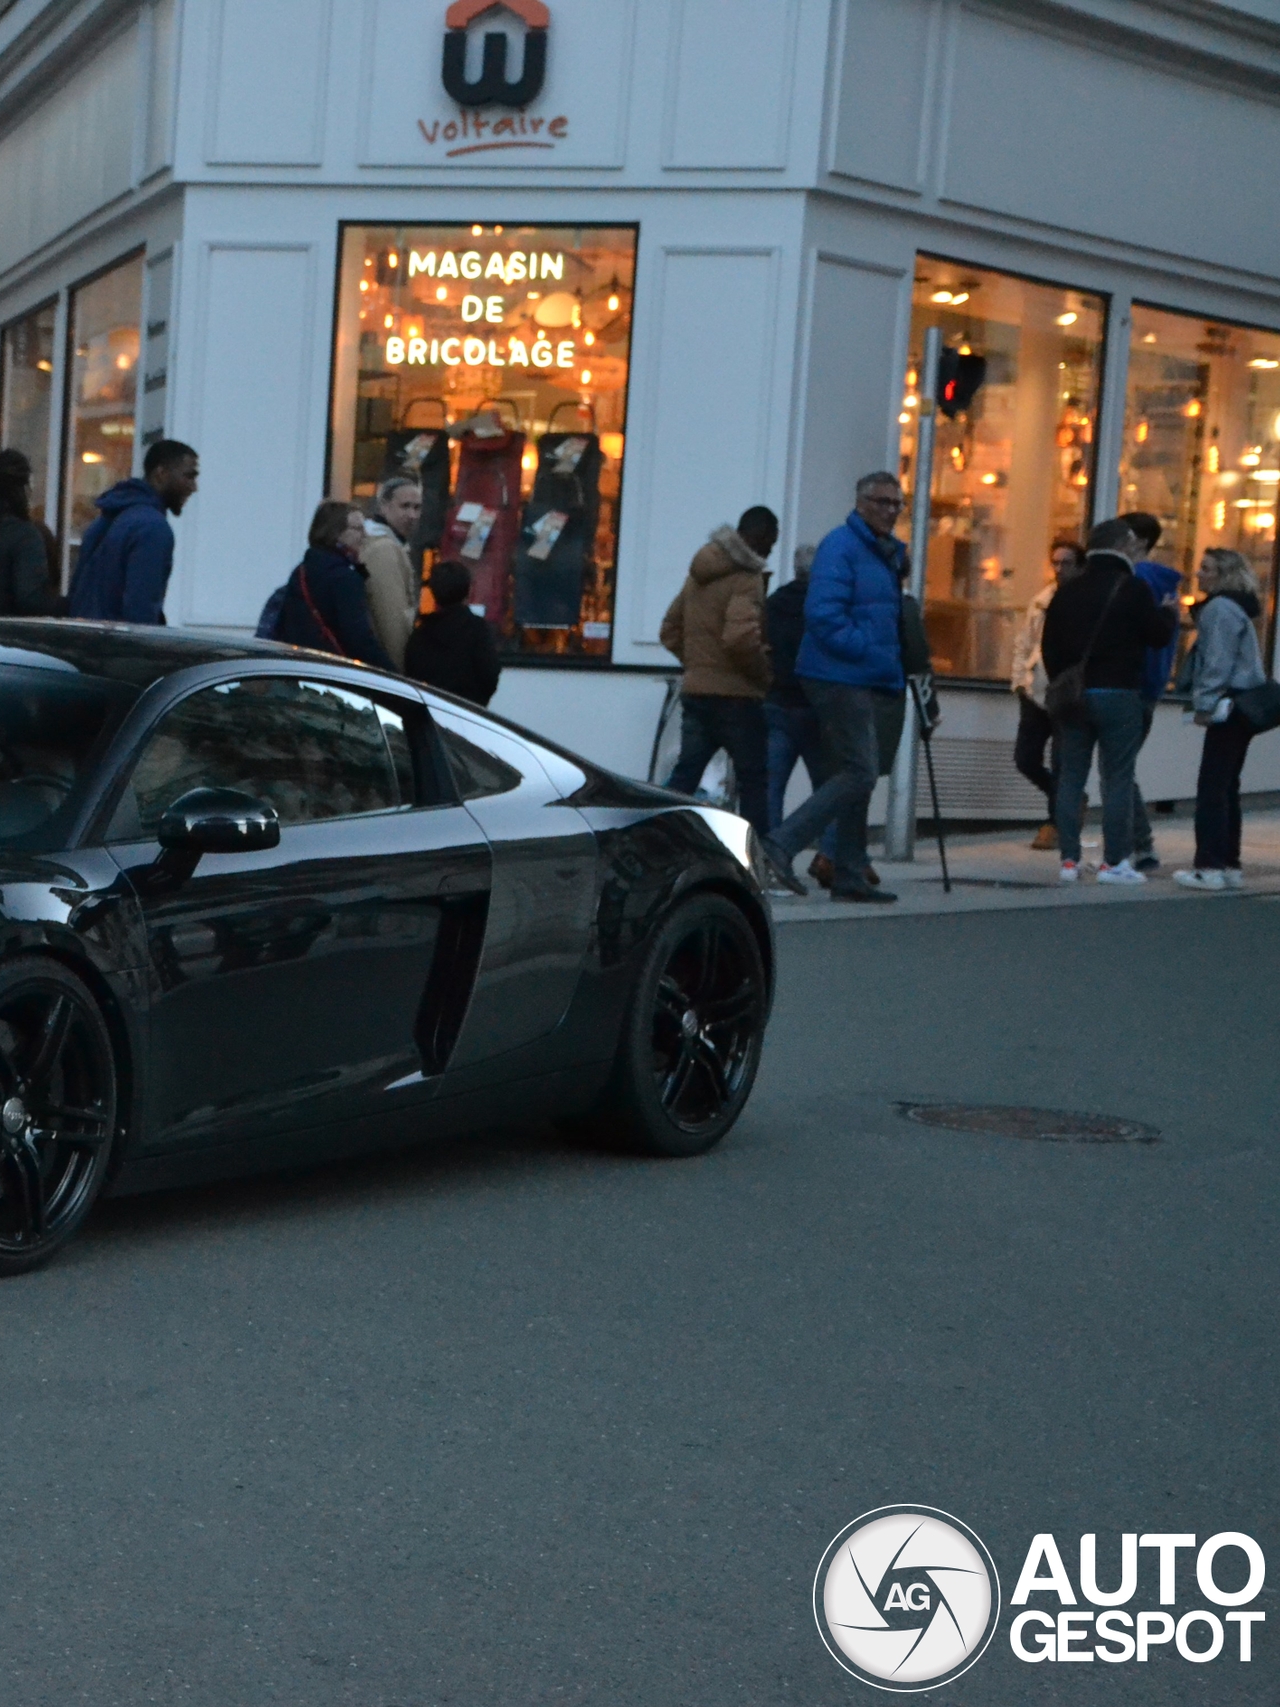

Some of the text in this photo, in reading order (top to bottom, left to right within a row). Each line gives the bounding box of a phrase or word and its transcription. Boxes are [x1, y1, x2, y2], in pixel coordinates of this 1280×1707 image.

[408, 250, 564, 280] MAGASIN
[461, 295, 504, 324] DE
[385, 336, 576, 368] BRICOLAGE
